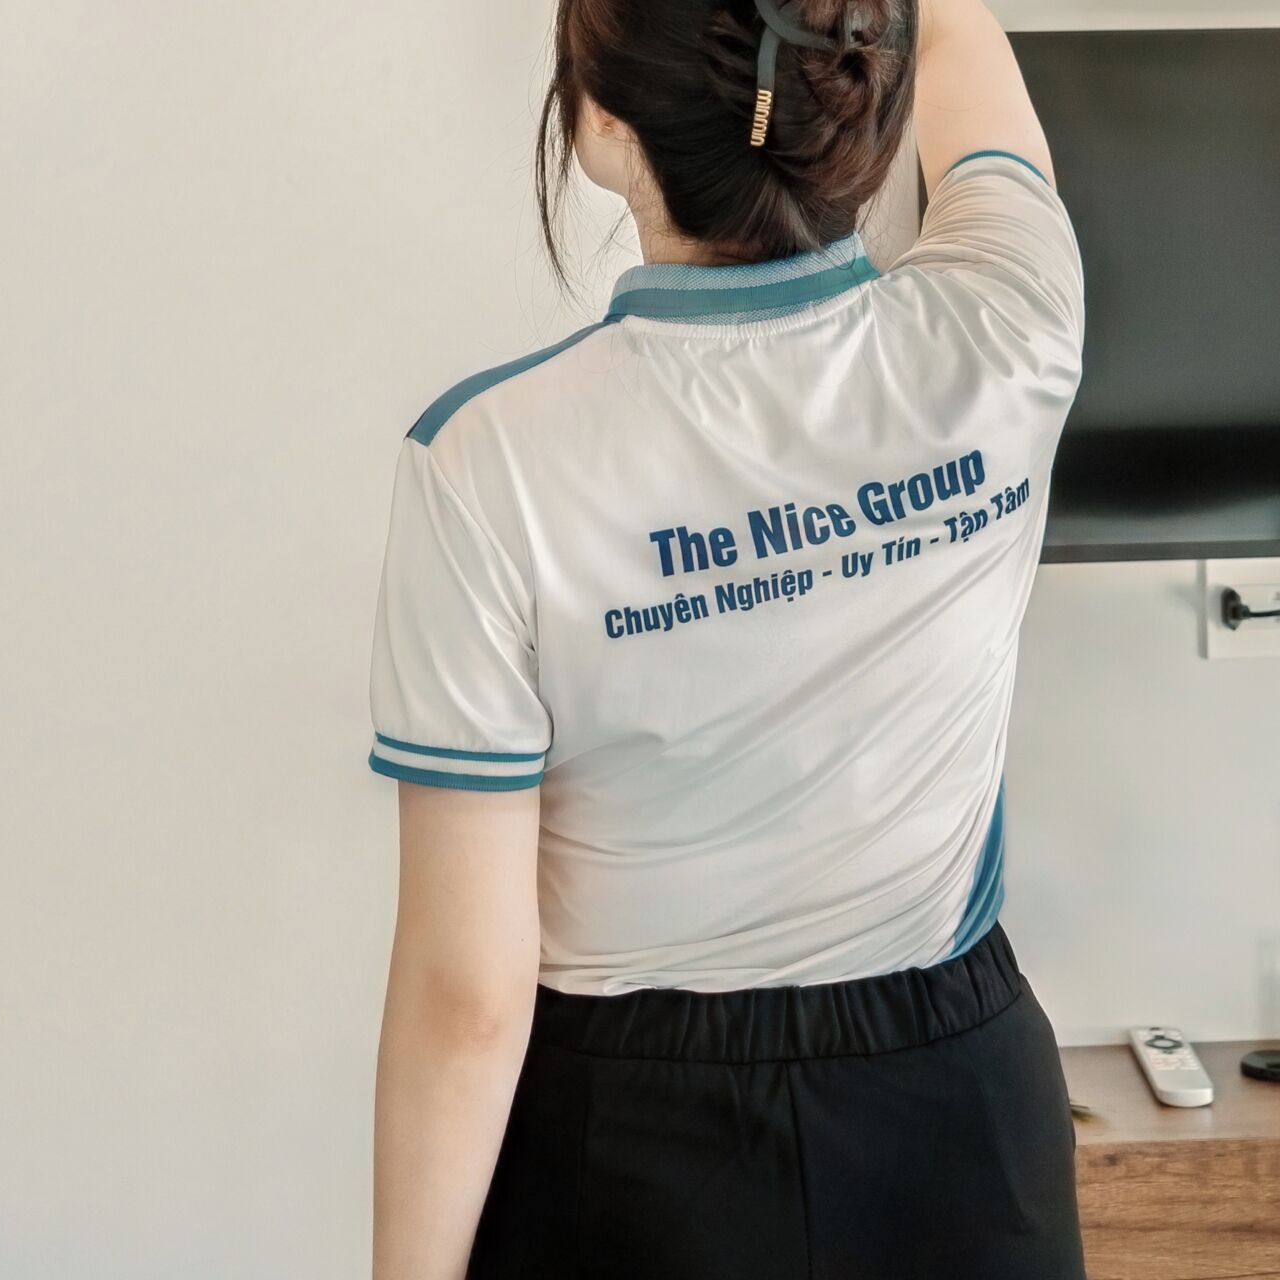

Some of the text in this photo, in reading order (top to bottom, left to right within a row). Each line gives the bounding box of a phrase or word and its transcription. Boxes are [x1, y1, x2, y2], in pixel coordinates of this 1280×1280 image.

[603, 592, 710, 639] Chuyên
[714, 568, 814, 614] Nghiệp
[842, 551, 873, 578] Uy
[882, 535, 922, 566] Tín
[943, 508, 989, 544] Tận
[990, 476, 1030, 519] Tâm
[649, 449, 986, 577] The Nice Group
